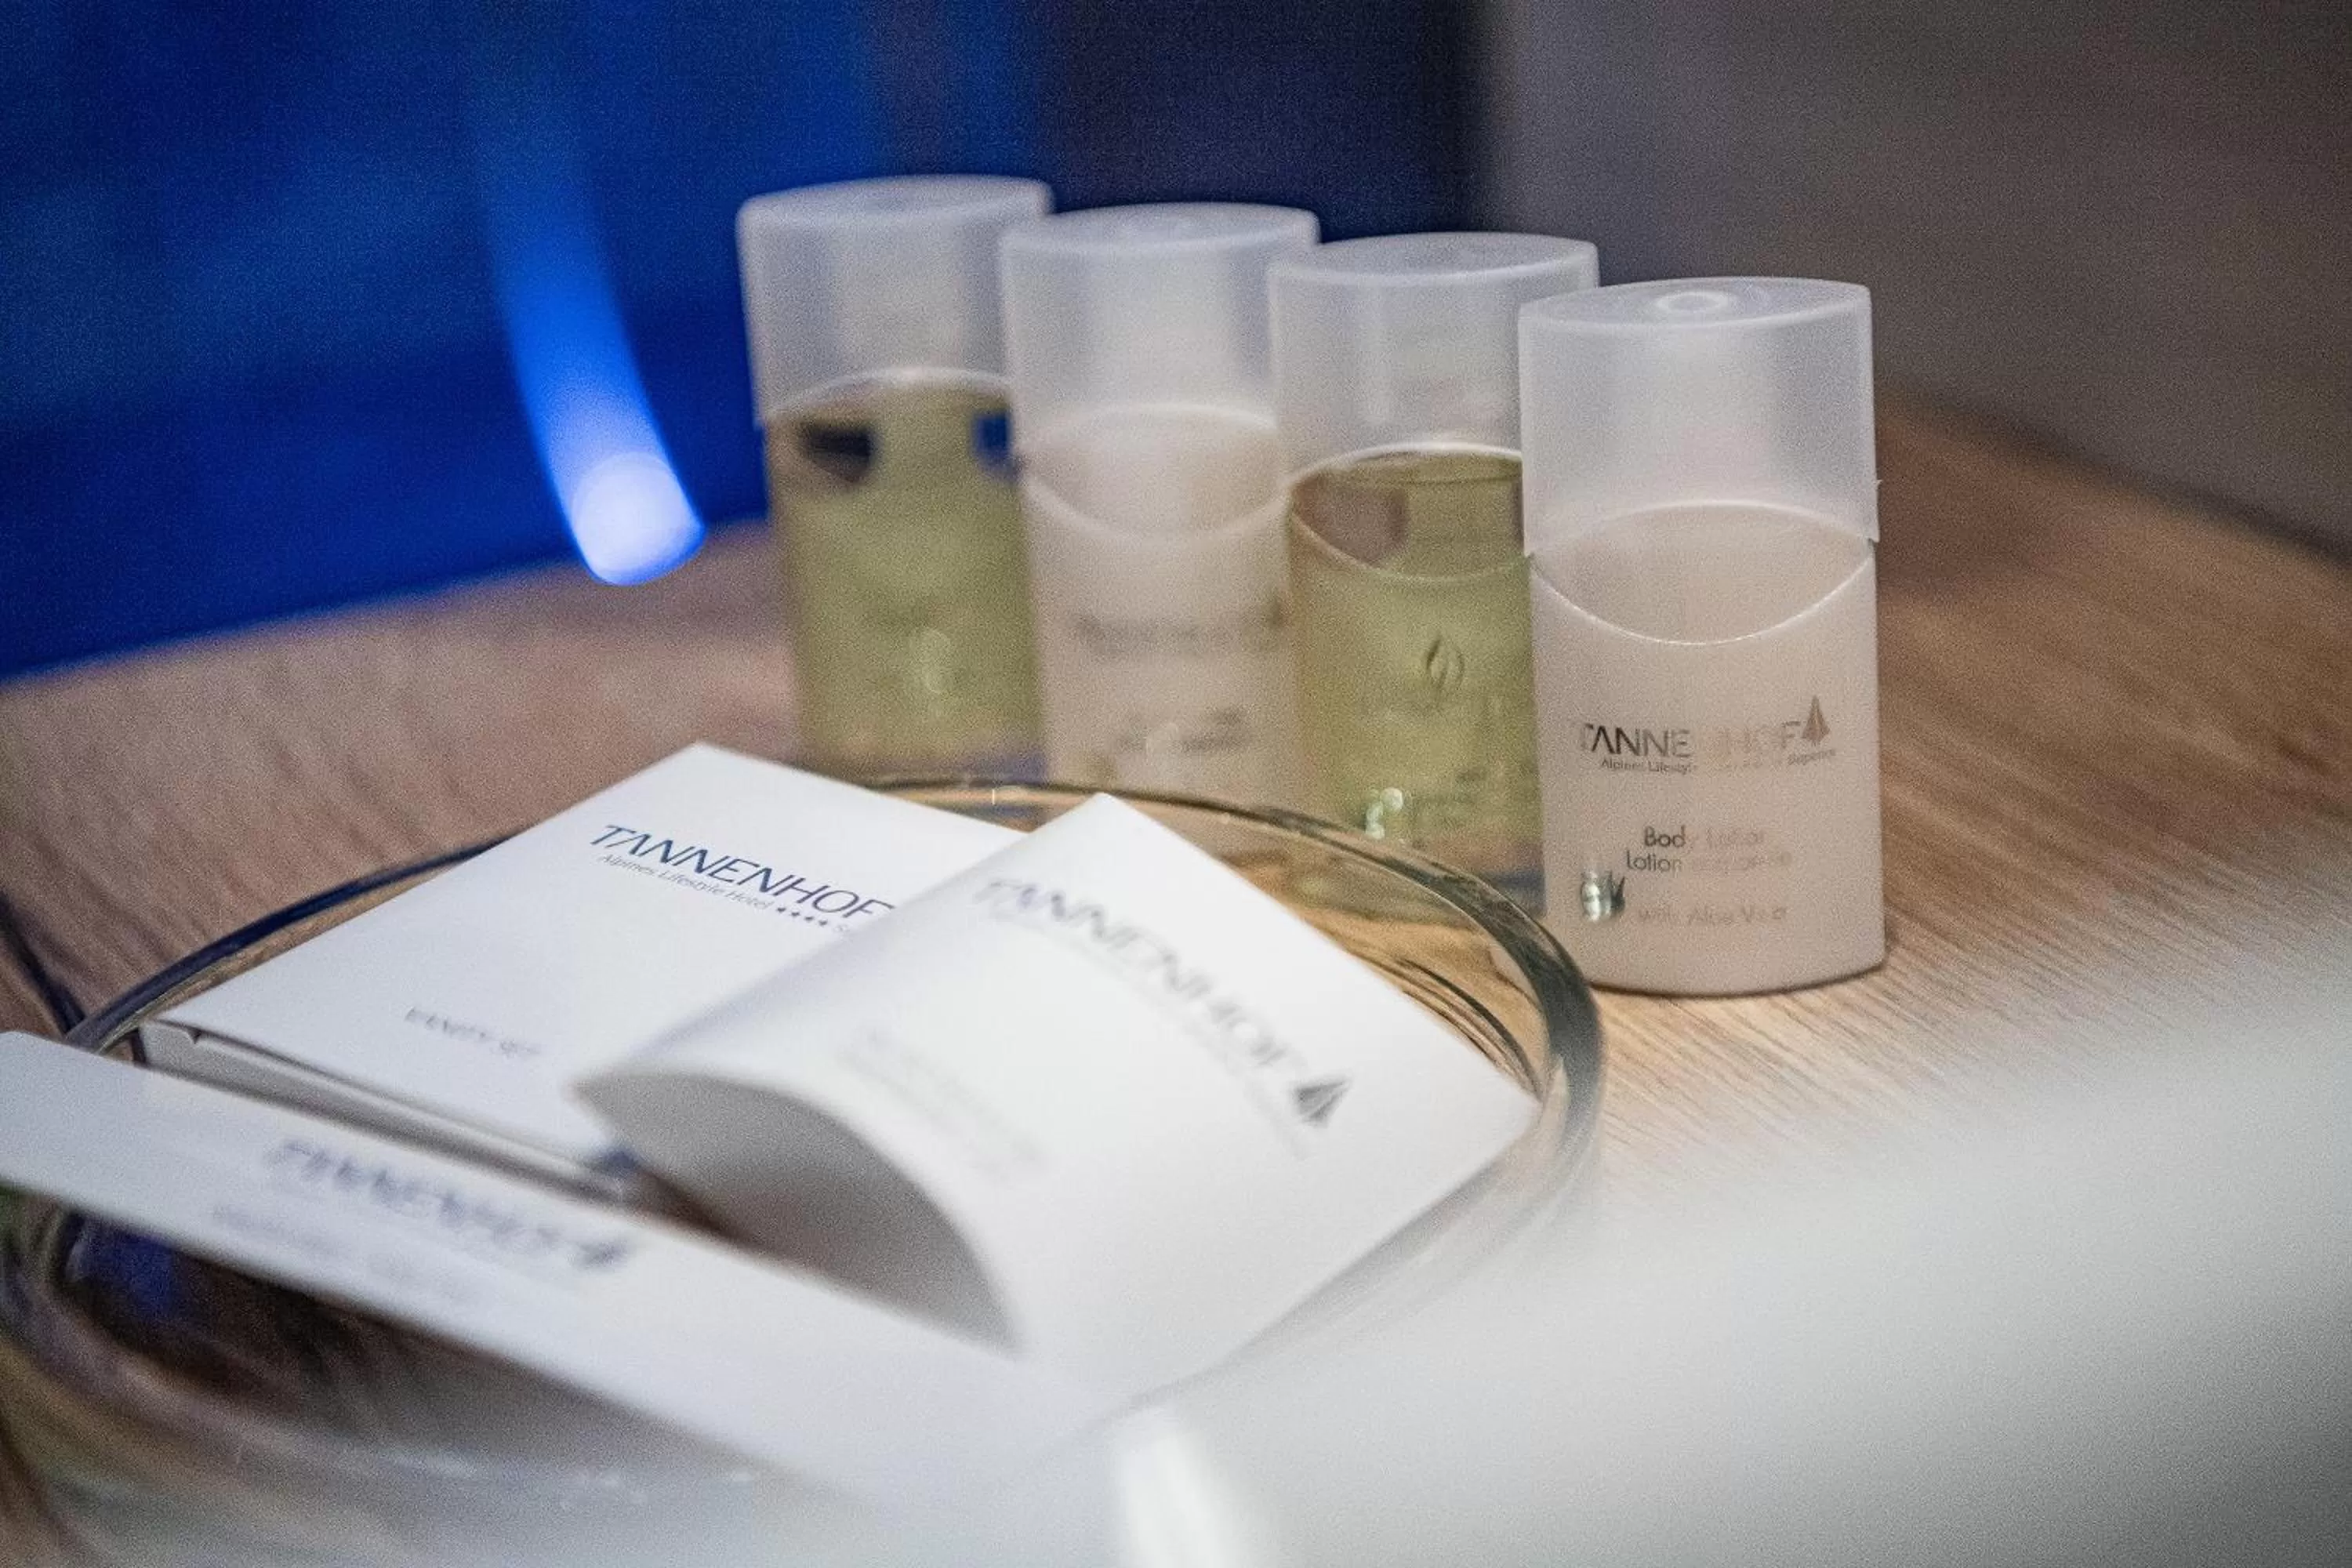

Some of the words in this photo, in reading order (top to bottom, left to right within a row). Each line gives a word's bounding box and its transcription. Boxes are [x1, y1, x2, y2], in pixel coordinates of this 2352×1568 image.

[1581, 720, 1802, 758] TANNEHOF
[590, 825, 895, 919] TANNENHOF
[1625, 849, 1683, 873] Lotion
[658, 869, 727, 895] Lifestyle
[728, 890, 775, 910] Hotel
